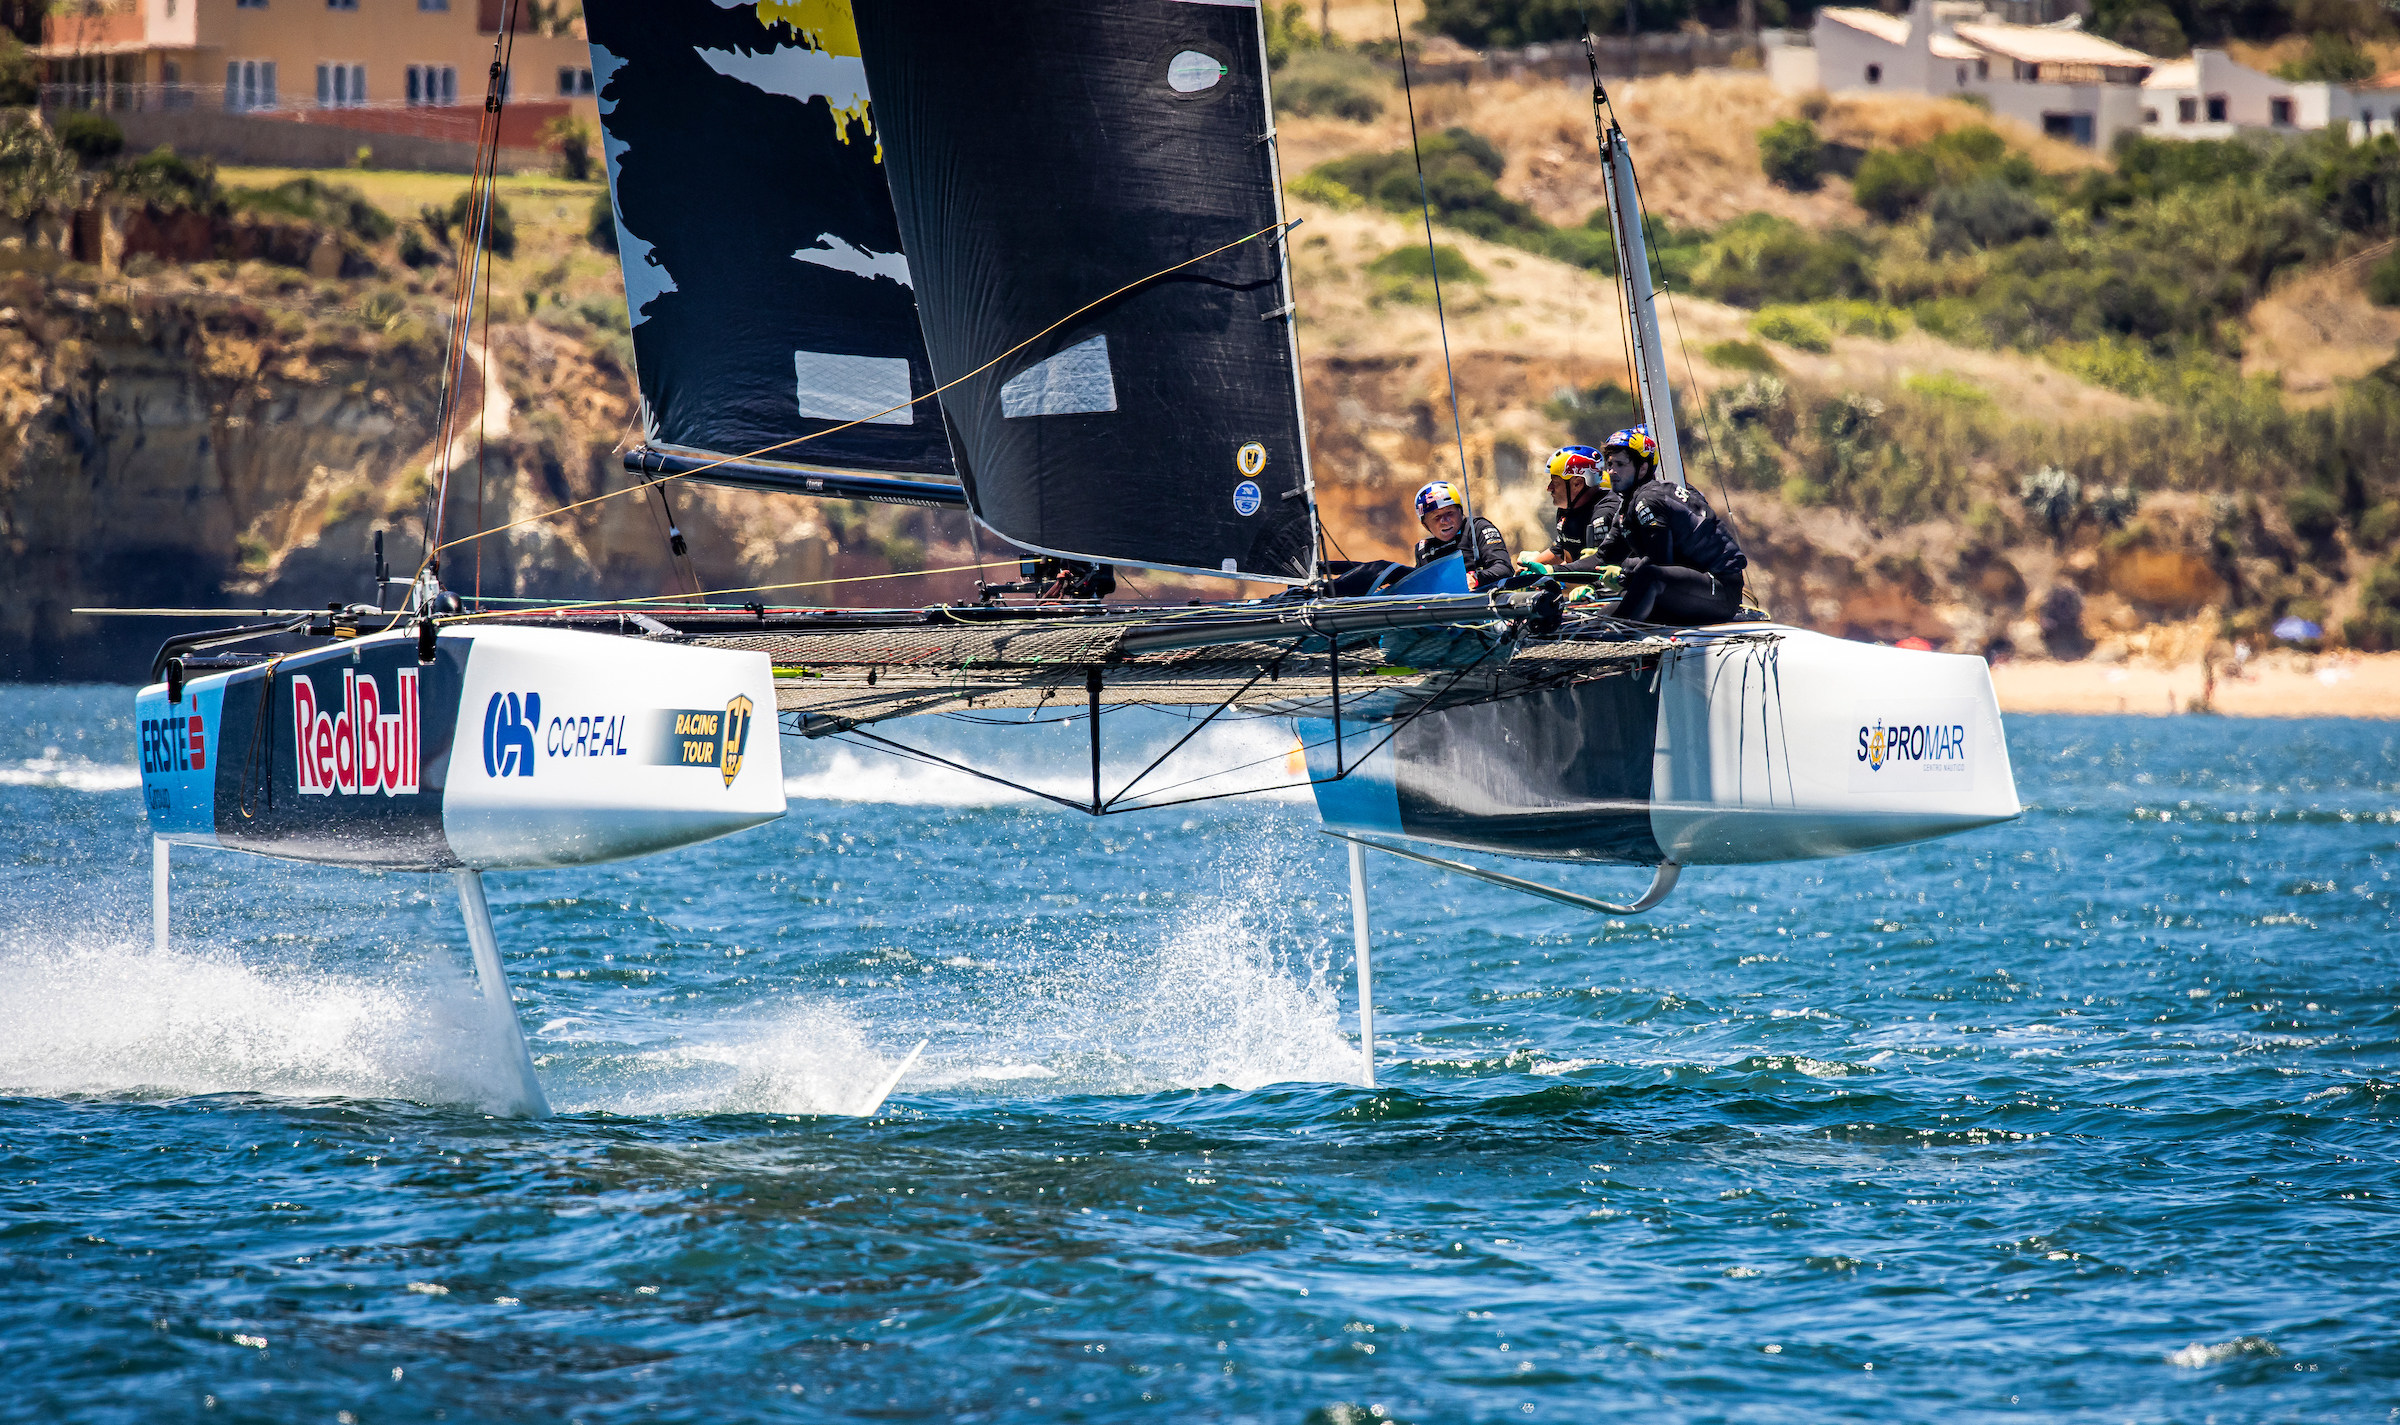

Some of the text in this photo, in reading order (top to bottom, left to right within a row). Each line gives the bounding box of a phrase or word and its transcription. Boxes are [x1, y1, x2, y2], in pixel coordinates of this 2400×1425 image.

[547, 715, 627, 757] CCREAL
[674, 714, 718, 736] RACING
[142, 717, 188, 774] ERSTE
[682, 741, 714, 763] TOUR
